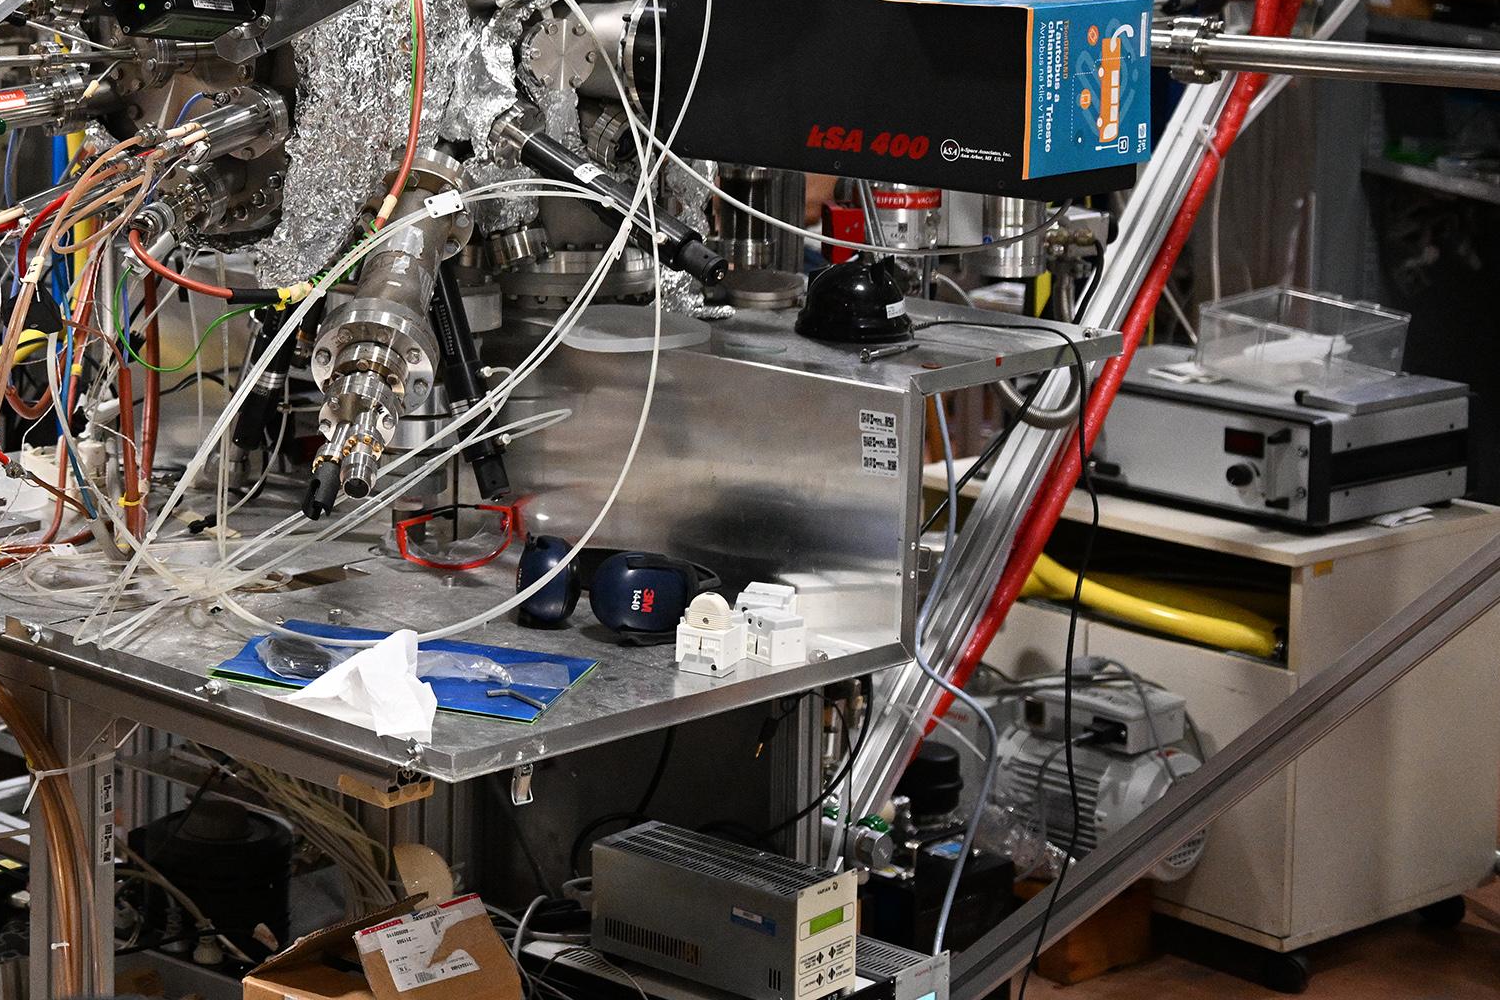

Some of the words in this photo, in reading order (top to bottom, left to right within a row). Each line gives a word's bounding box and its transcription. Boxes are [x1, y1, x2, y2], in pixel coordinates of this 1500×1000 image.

[1039, 22, 1047, 66] Avtobus
[1046, 21, 1055, 88] chiamata
[1054, 21, 1063, 90] L'autobus
[1039, 69, 1044, 82] na
[1046, 92, 1052, 100] a
[1054, 95, 1060, 103] a
[806, 124, 863, 153] kSA
[870, 132, 930, 160] 400
[1037, 113, 1045, 140] Trstu
[1045, 103, 1054, 153] Trieste
[641, 588, 655, 613] 3M
